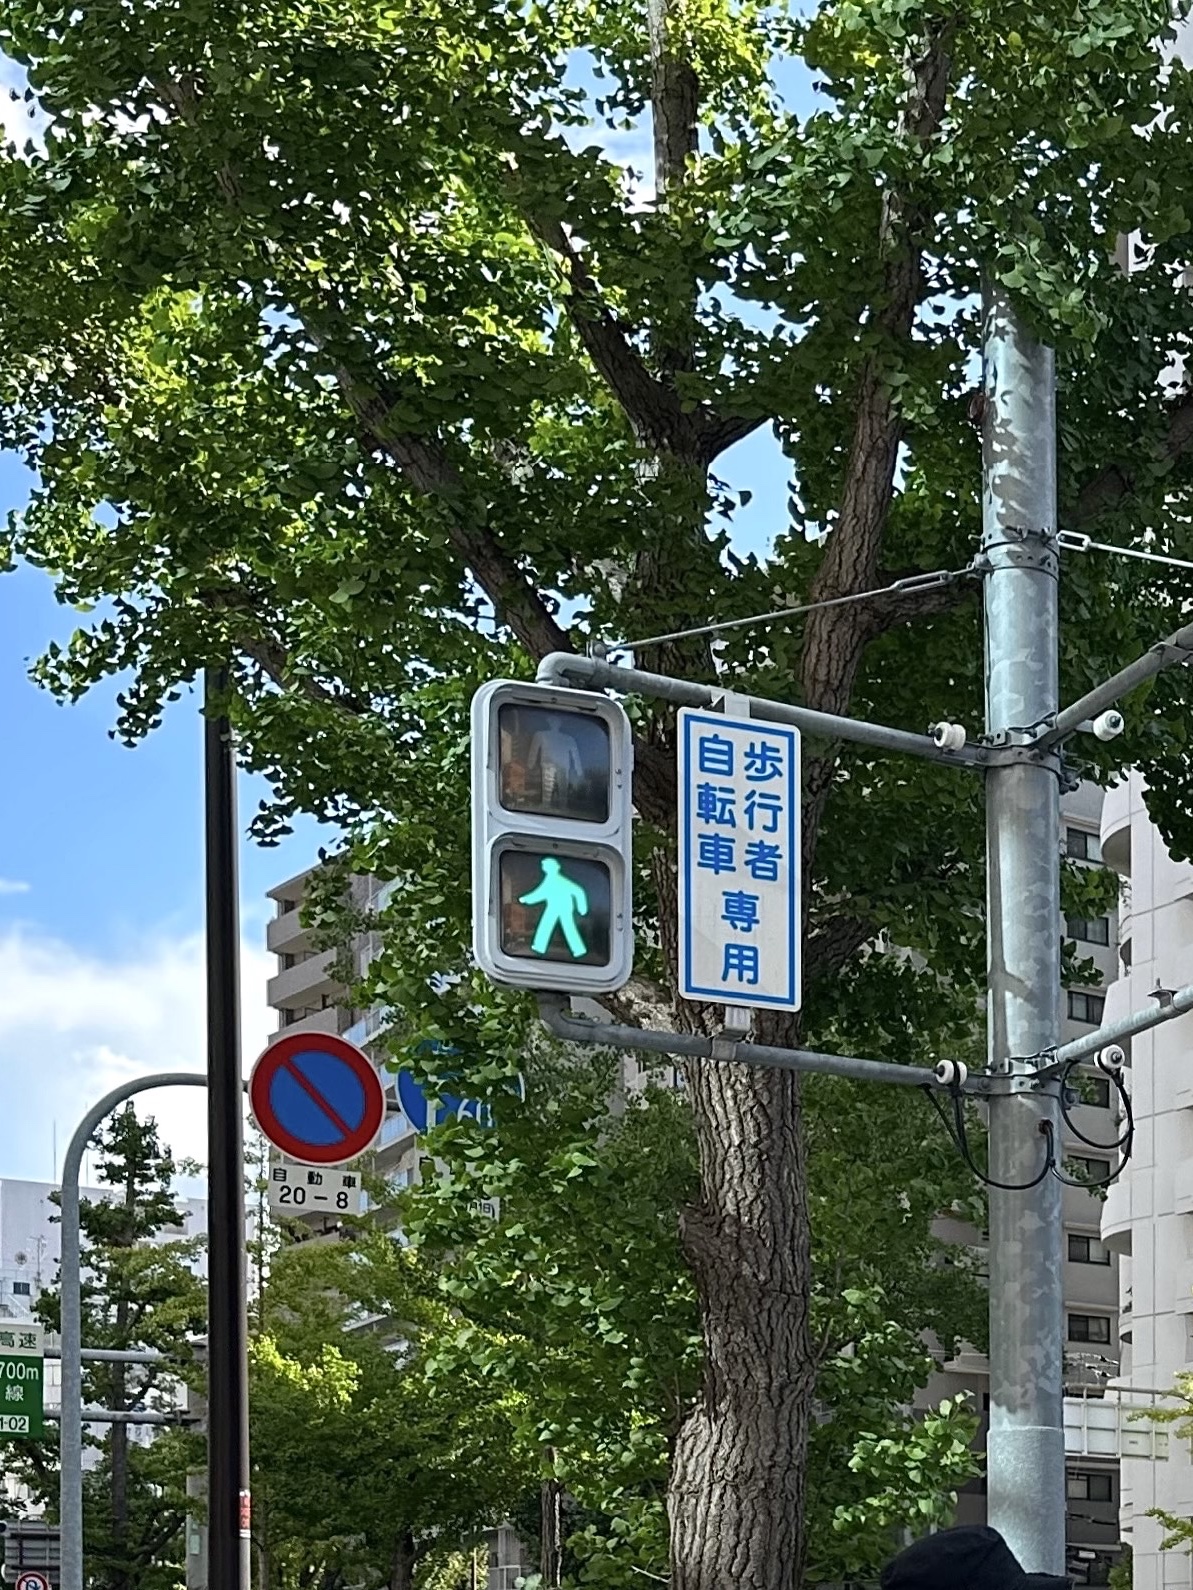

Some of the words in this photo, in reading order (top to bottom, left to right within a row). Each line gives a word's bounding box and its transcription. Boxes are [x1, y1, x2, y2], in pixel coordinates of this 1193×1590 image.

[697, 734, 736, 875] 自転車
[744, 741, 783, 881] 歩行者
[721, 891, 761, 985] 専用
[273, 1167, 357, 1189] 自動車
